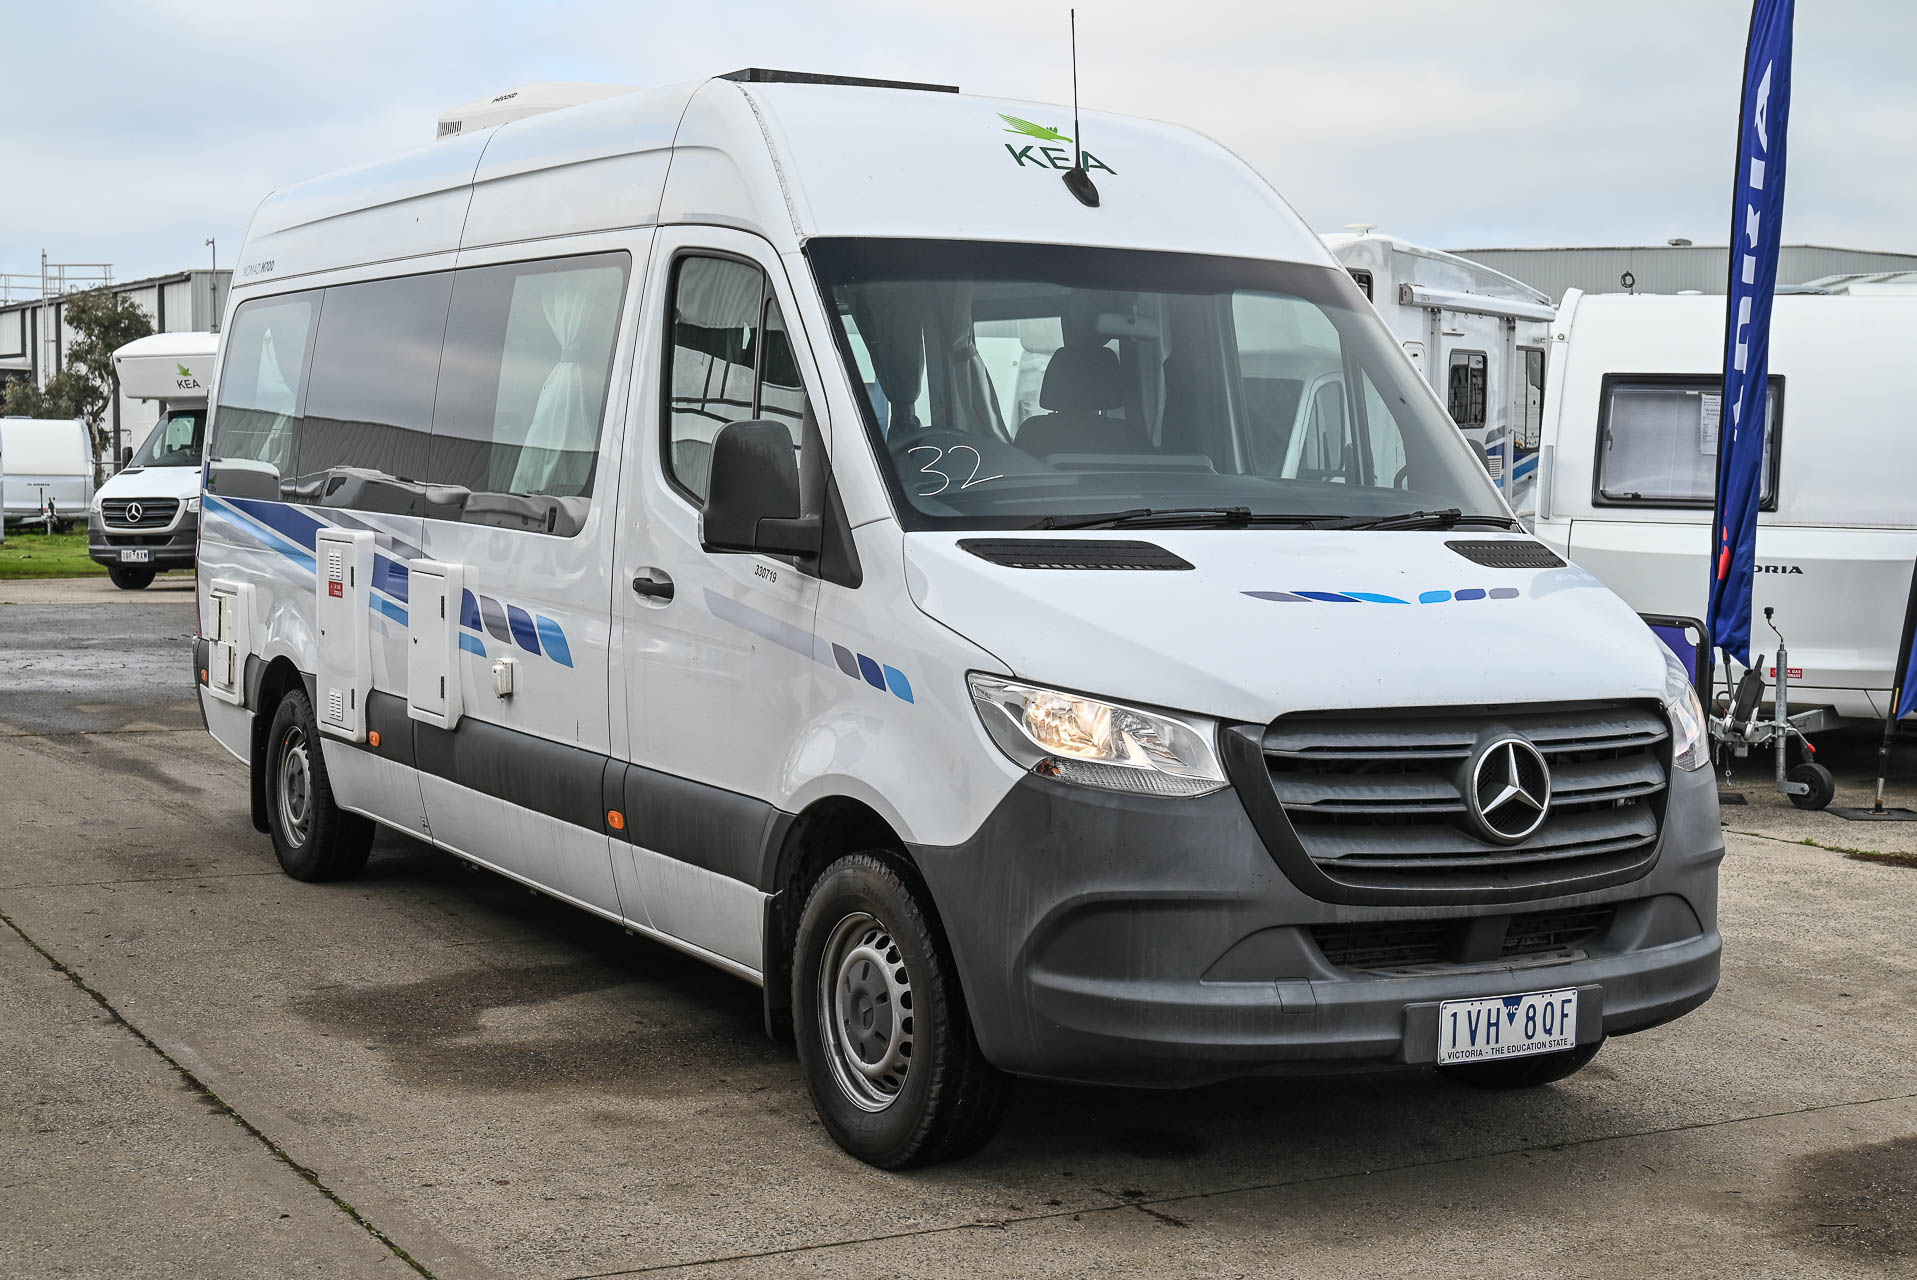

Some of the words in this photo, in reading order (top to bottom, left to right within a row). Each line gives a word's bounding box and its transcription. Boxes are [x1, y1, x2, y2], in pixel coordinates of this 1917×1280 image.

[1004, 143, 1118, 176] KEA
[176, 379, 201, 390] KEA
[907, 445, 1004, 496] 32
[754, 564, 778, 583] 330719
[1753, 564, 1804, 574] DRIA
[1503, 1005, 1519, 1013] VIC
[1450, 1007, 1501, 1048] 1VH
[1524, 998, 1573, 1040] 8QF
[1447, 1048, 1484, 1060] VICTORIA
[1490, 1046, 1505, 1055] THE
[1506, 1040, 1547, 1054] EDUCATION
[1548, 1037, 1568, 1049] STATE
